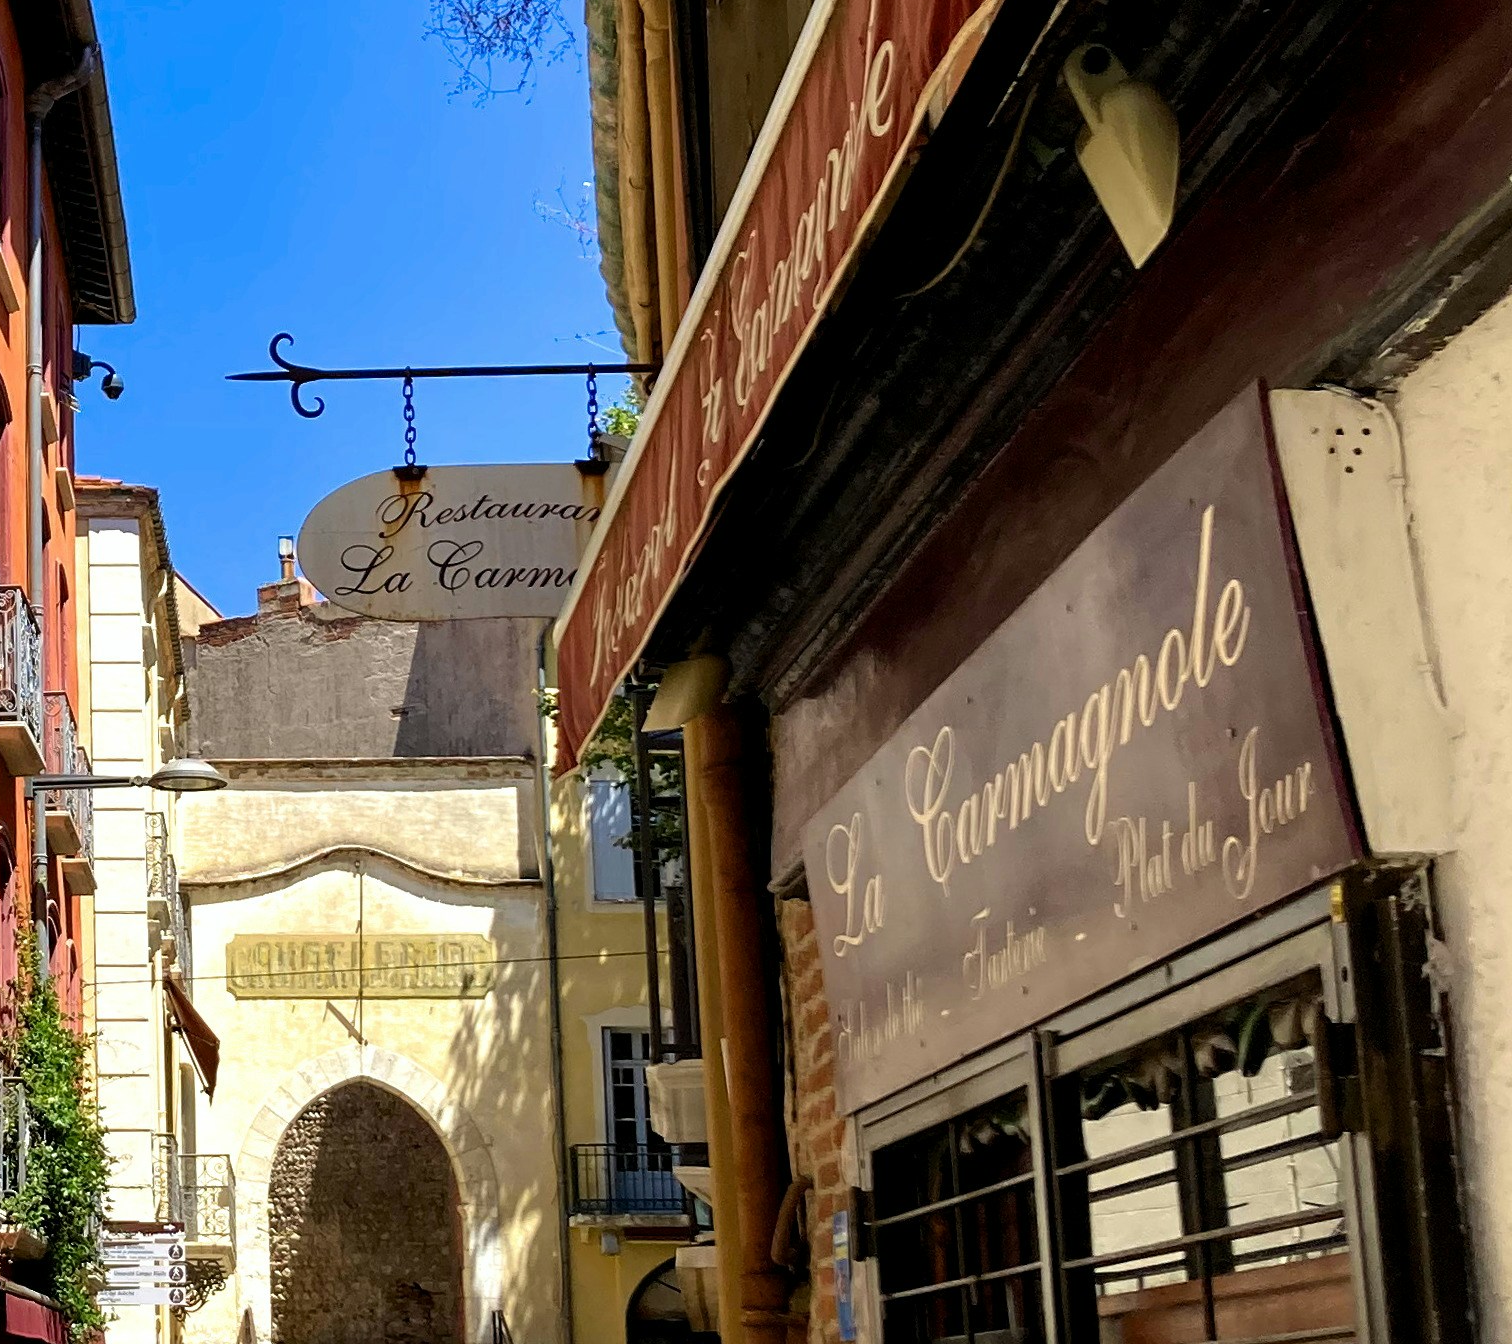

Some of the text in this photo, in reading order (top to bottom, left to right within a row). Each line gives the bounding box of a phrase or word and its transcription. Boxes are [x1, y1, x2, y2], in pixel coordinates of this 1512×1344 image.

[334, 545, 413, 596] La
[376, 492, 601, 538] Restaura
[826, 505, 1251, 957] La Carmagnole
[1108, 816, 1173, 918] Plat
[1181, 781, 1216, 875] du
[1222, 726, 1316, 900] Jour
